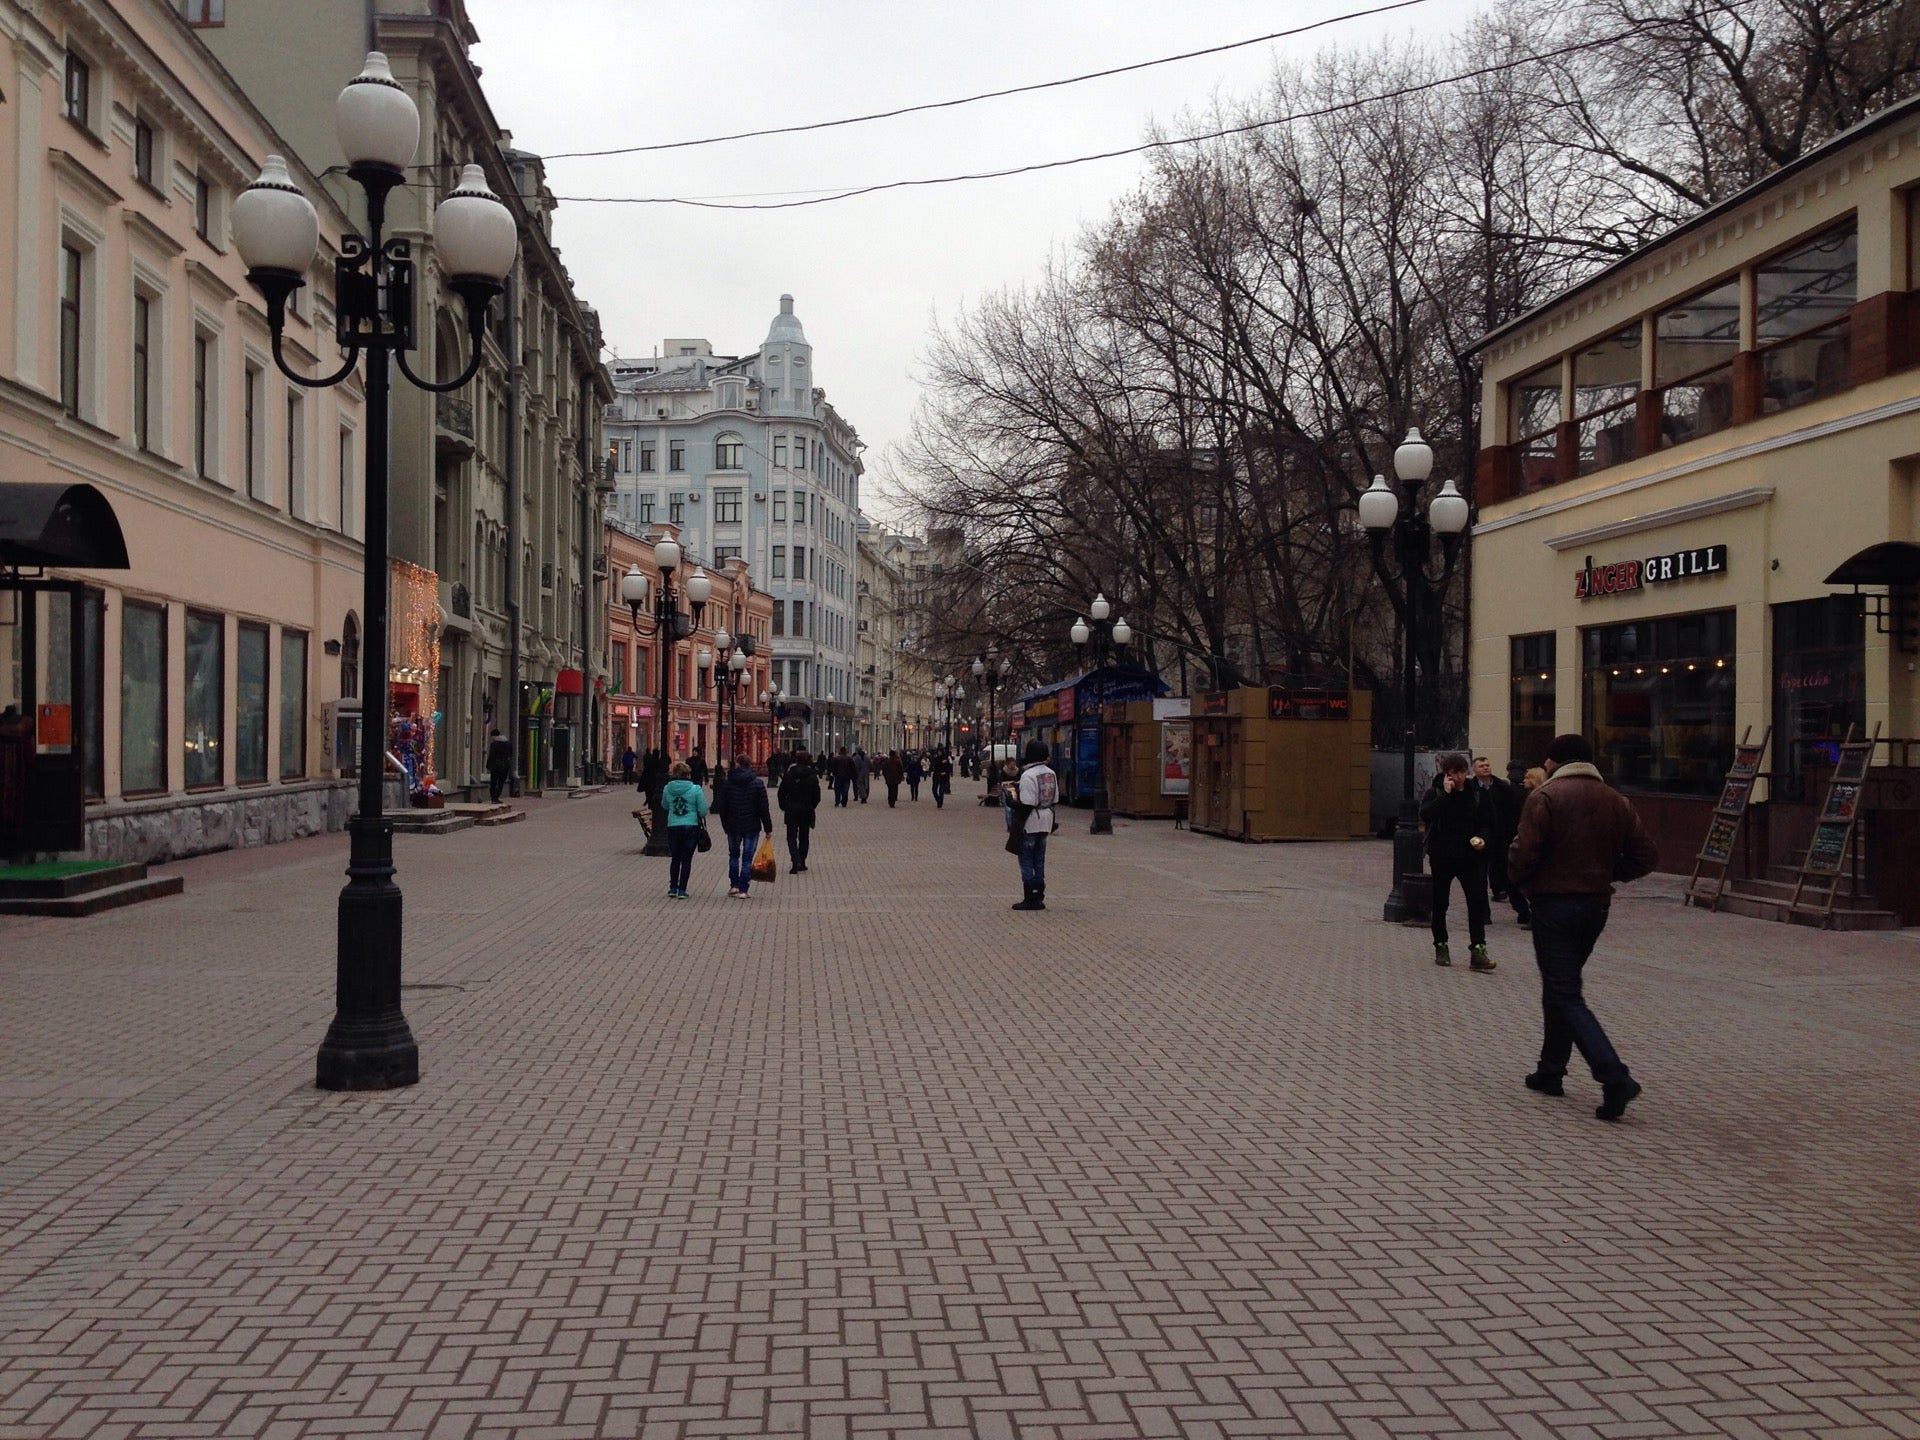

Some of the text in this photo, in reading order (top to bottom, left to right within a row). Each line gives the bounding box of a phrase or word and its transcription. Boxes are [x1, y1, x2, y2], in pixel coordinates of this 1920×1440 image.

[1574, 548, 1720, 598] ZINGER GRILL
[1328, 699, 1347, 709] WC
